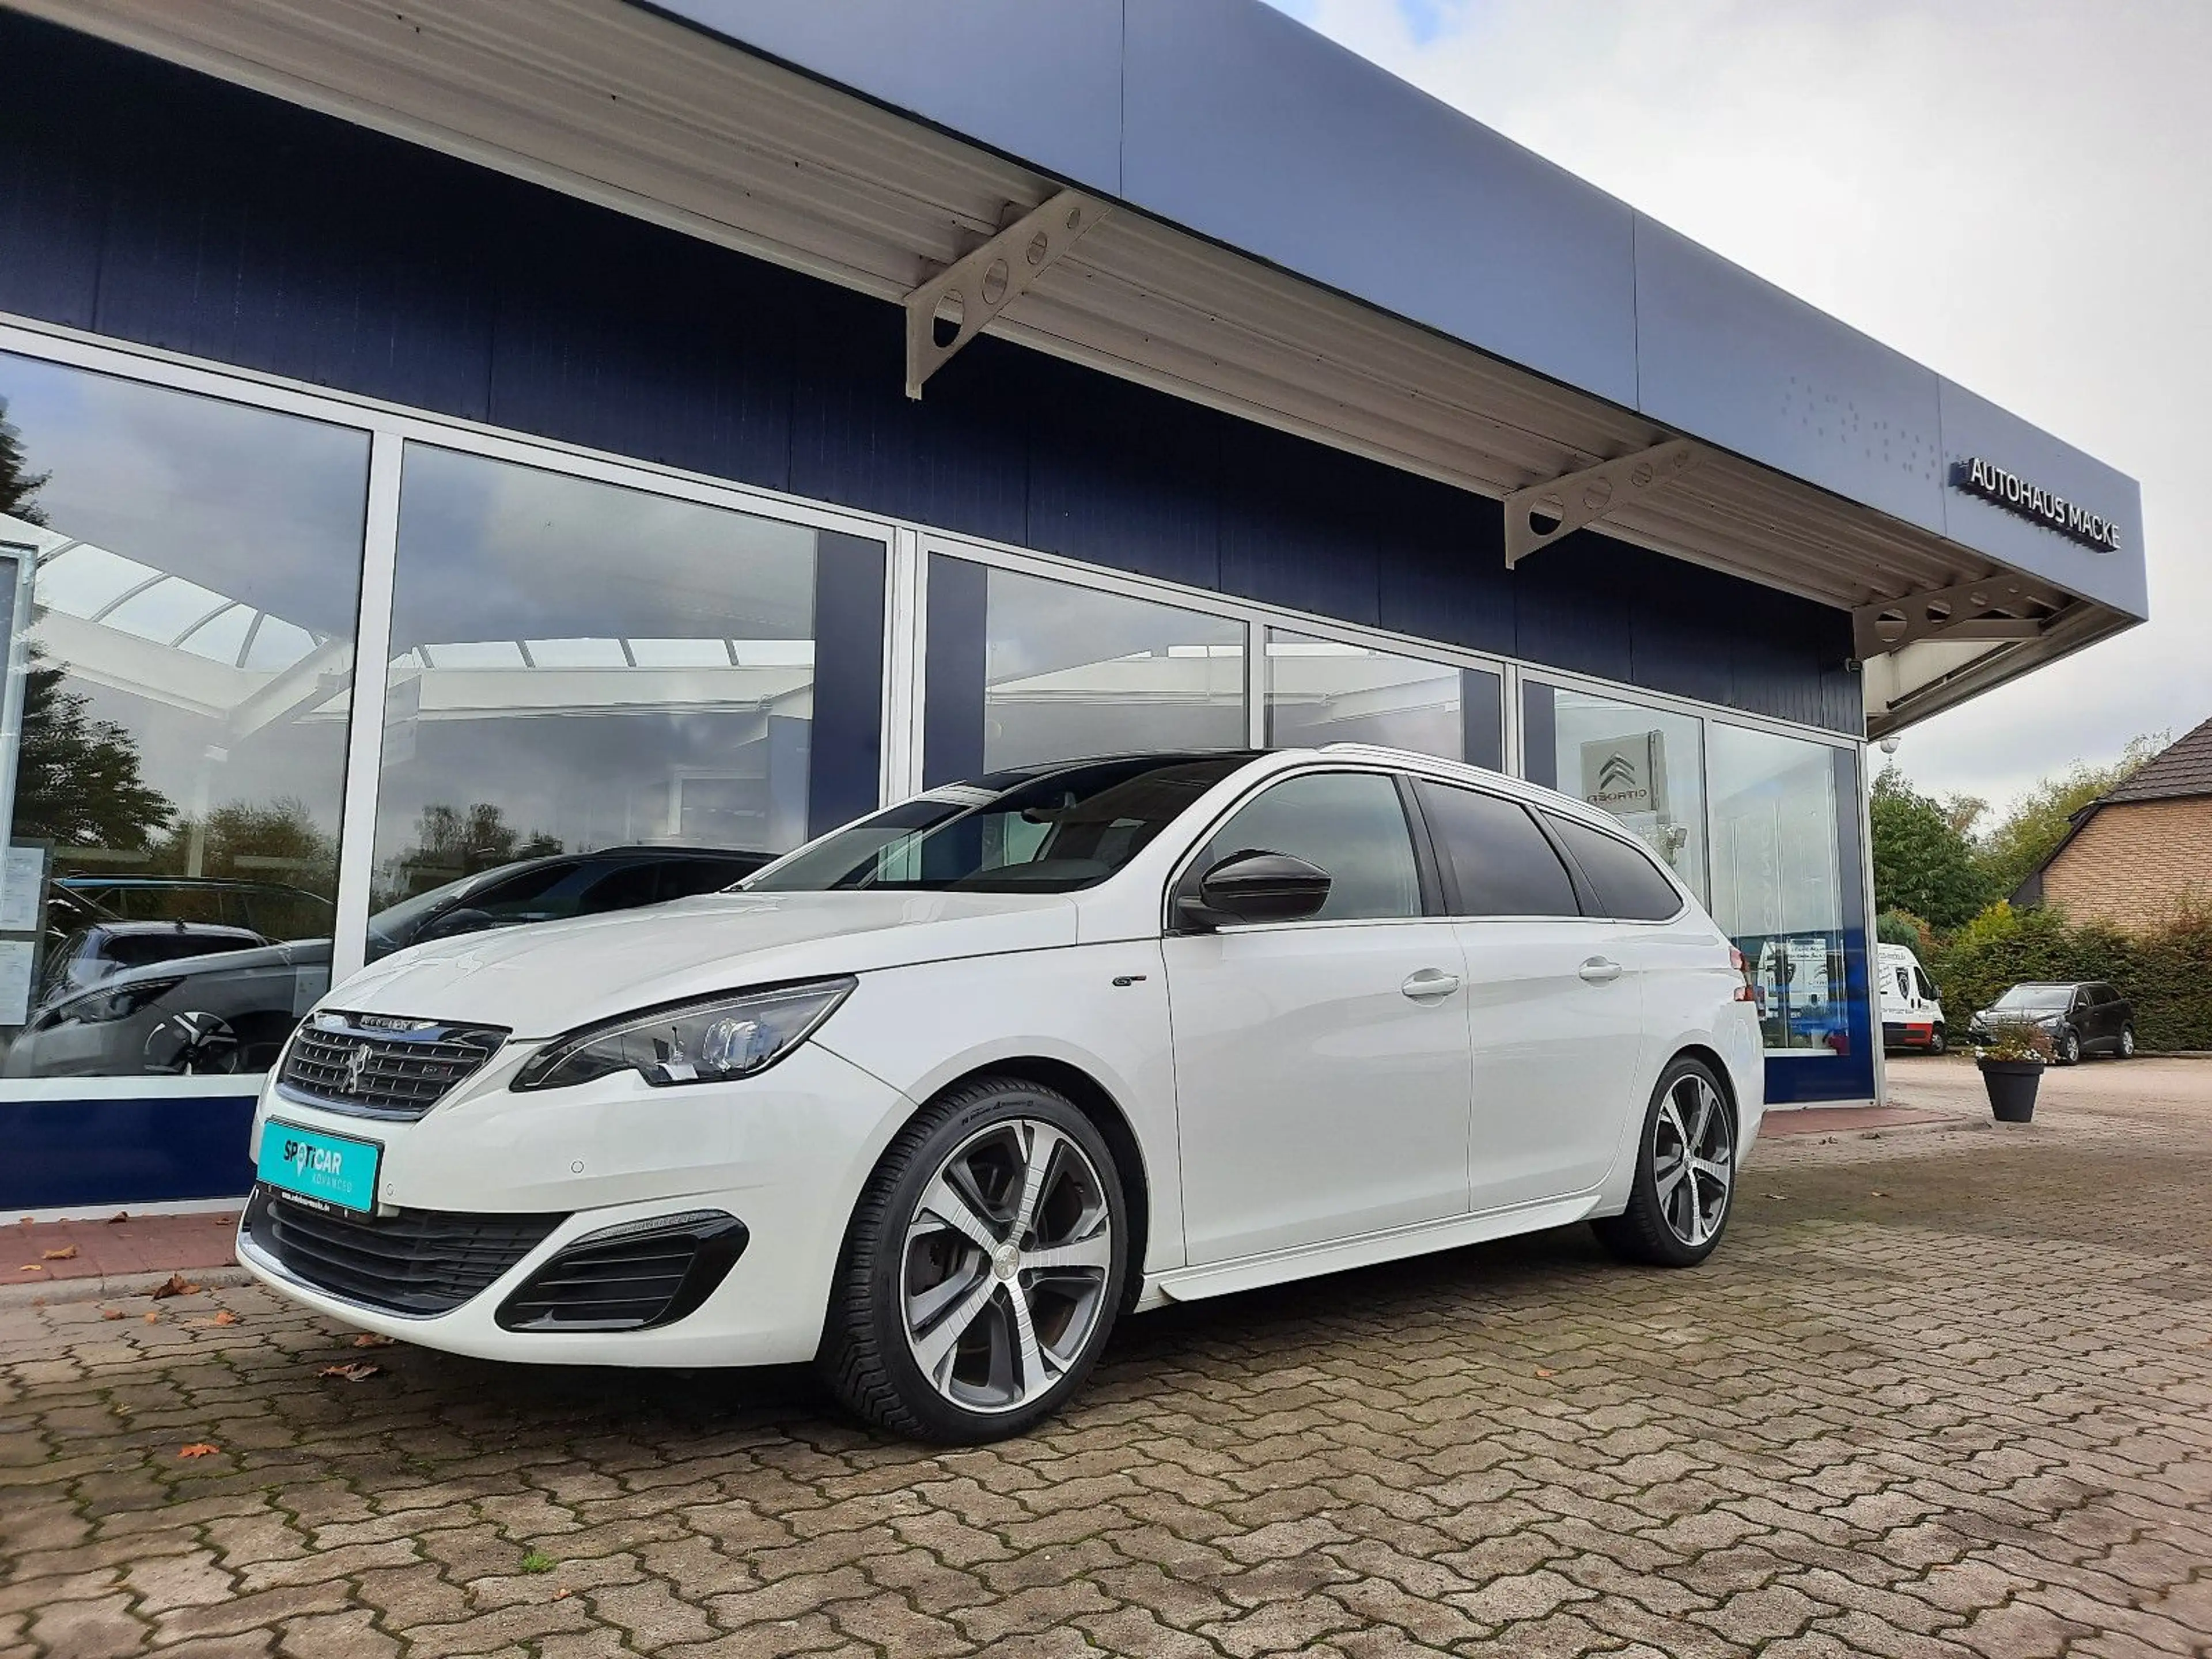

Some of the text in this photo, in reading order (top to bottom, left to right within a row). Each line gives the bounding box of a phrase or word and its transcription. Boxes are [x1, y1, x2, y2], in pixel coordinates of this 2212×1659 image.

[1970, 457, 2121, 548] AUTOHAUS MACKE
[312, 1173, 353, 1193] ADVANCED
